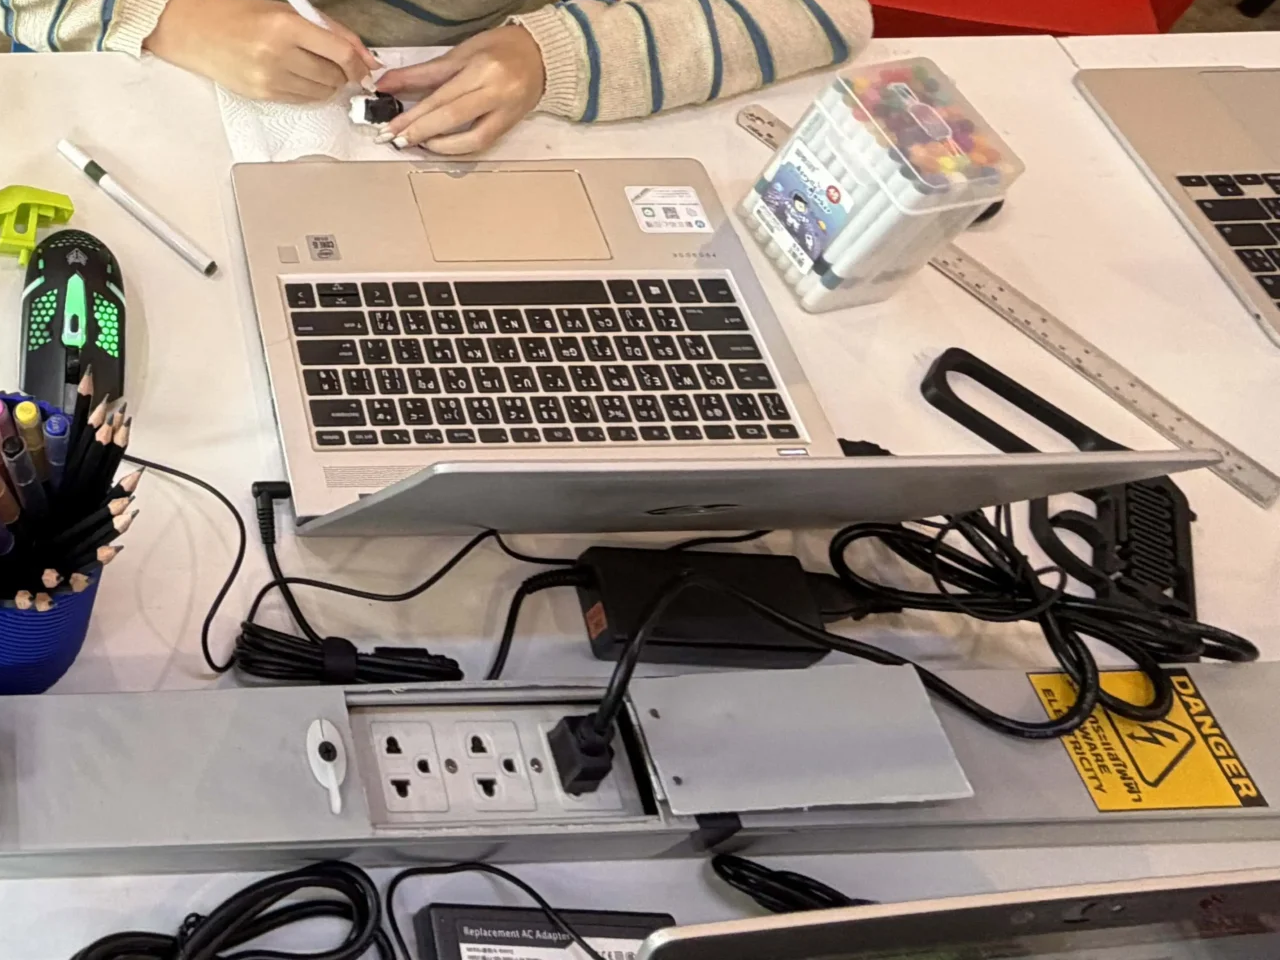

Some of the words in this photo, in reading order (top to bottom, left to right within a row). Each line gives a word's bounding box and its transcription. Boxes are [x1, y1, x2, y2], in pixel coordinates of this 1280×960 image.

[1171, 675, 1259, 799] DANGER
[463, 926, 520, 939] Replacement
[521, 929, 534, 939] AC
